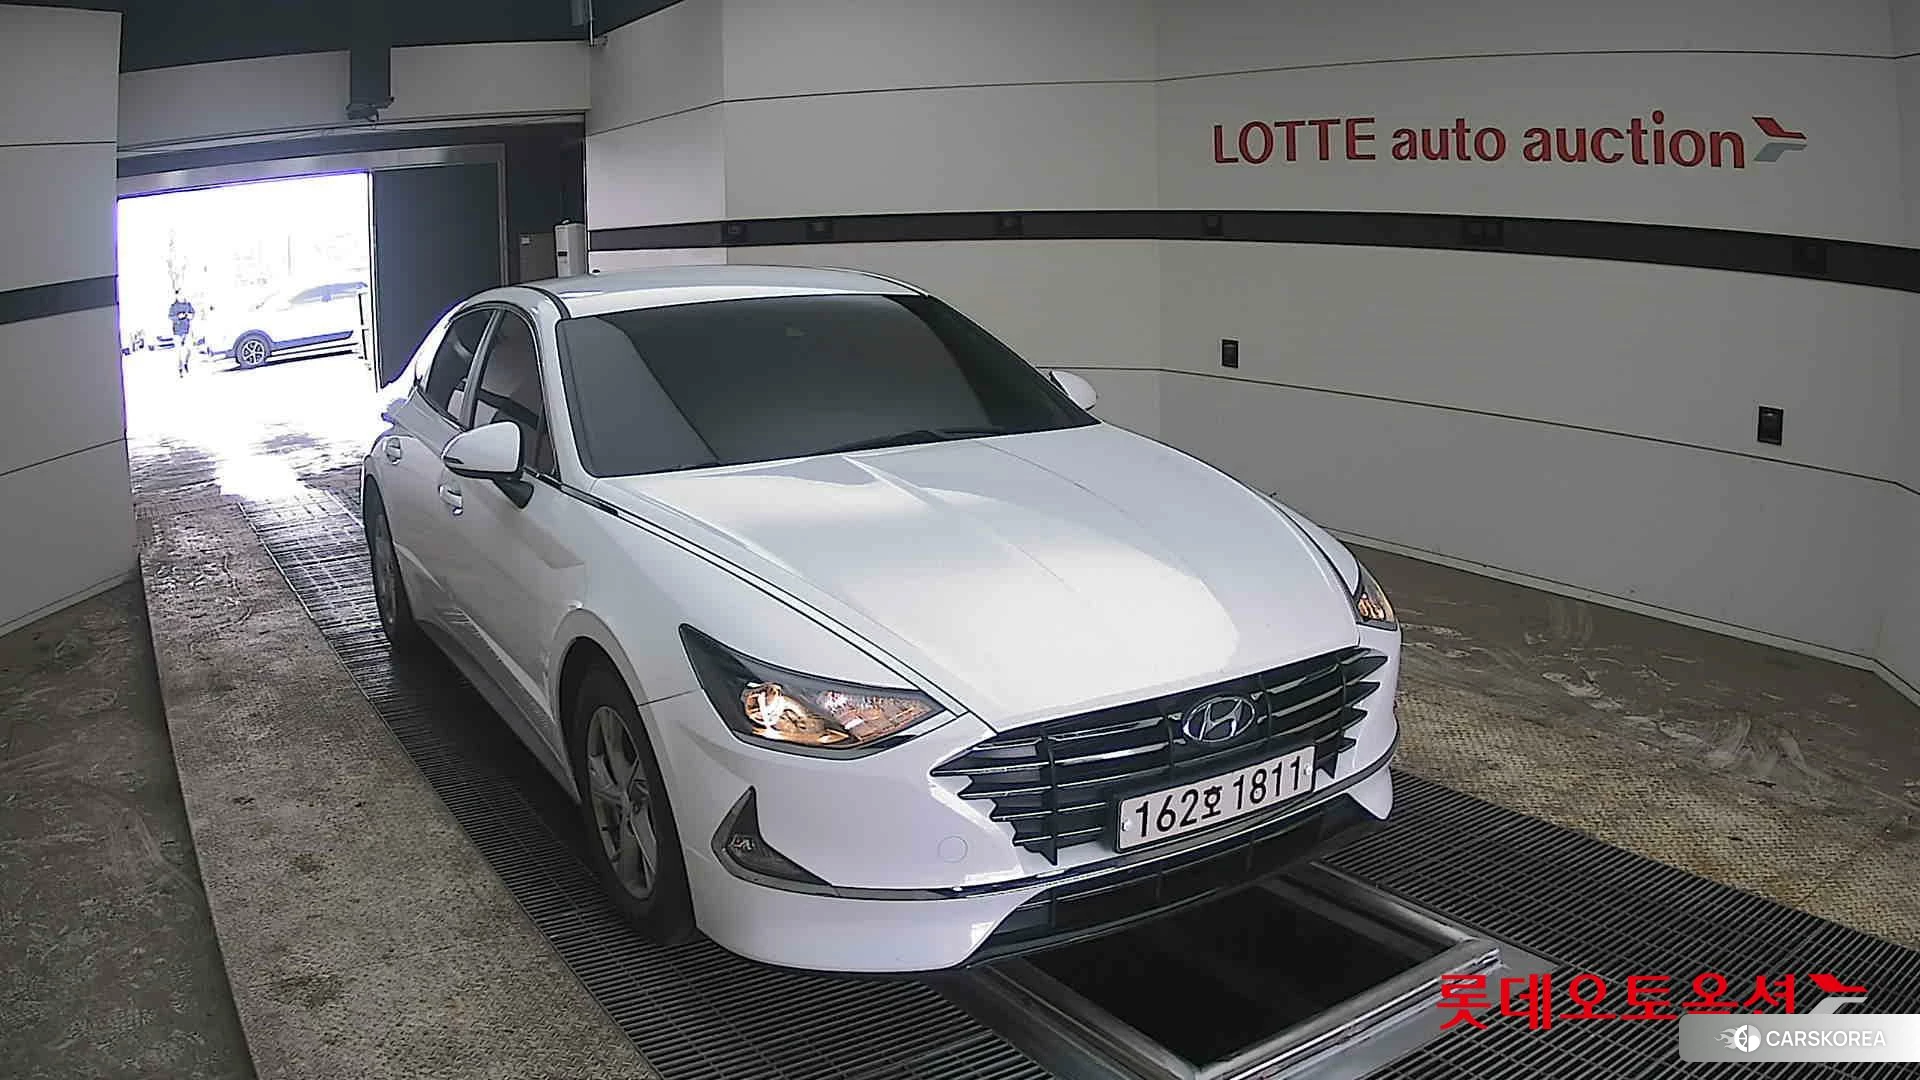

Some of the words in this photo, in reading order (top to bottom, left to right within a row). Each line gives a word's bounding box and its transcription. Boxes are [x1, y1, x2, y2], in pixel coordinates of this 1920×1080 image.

[1213, 117, 1376, 165] LOTTE
[1391, 118, 1507, 162] auto
[1522, 110, 1746, 169] auction
[1135, 785, 1223, 838] 162호
[1232, 755, 1301, 810] 1811
